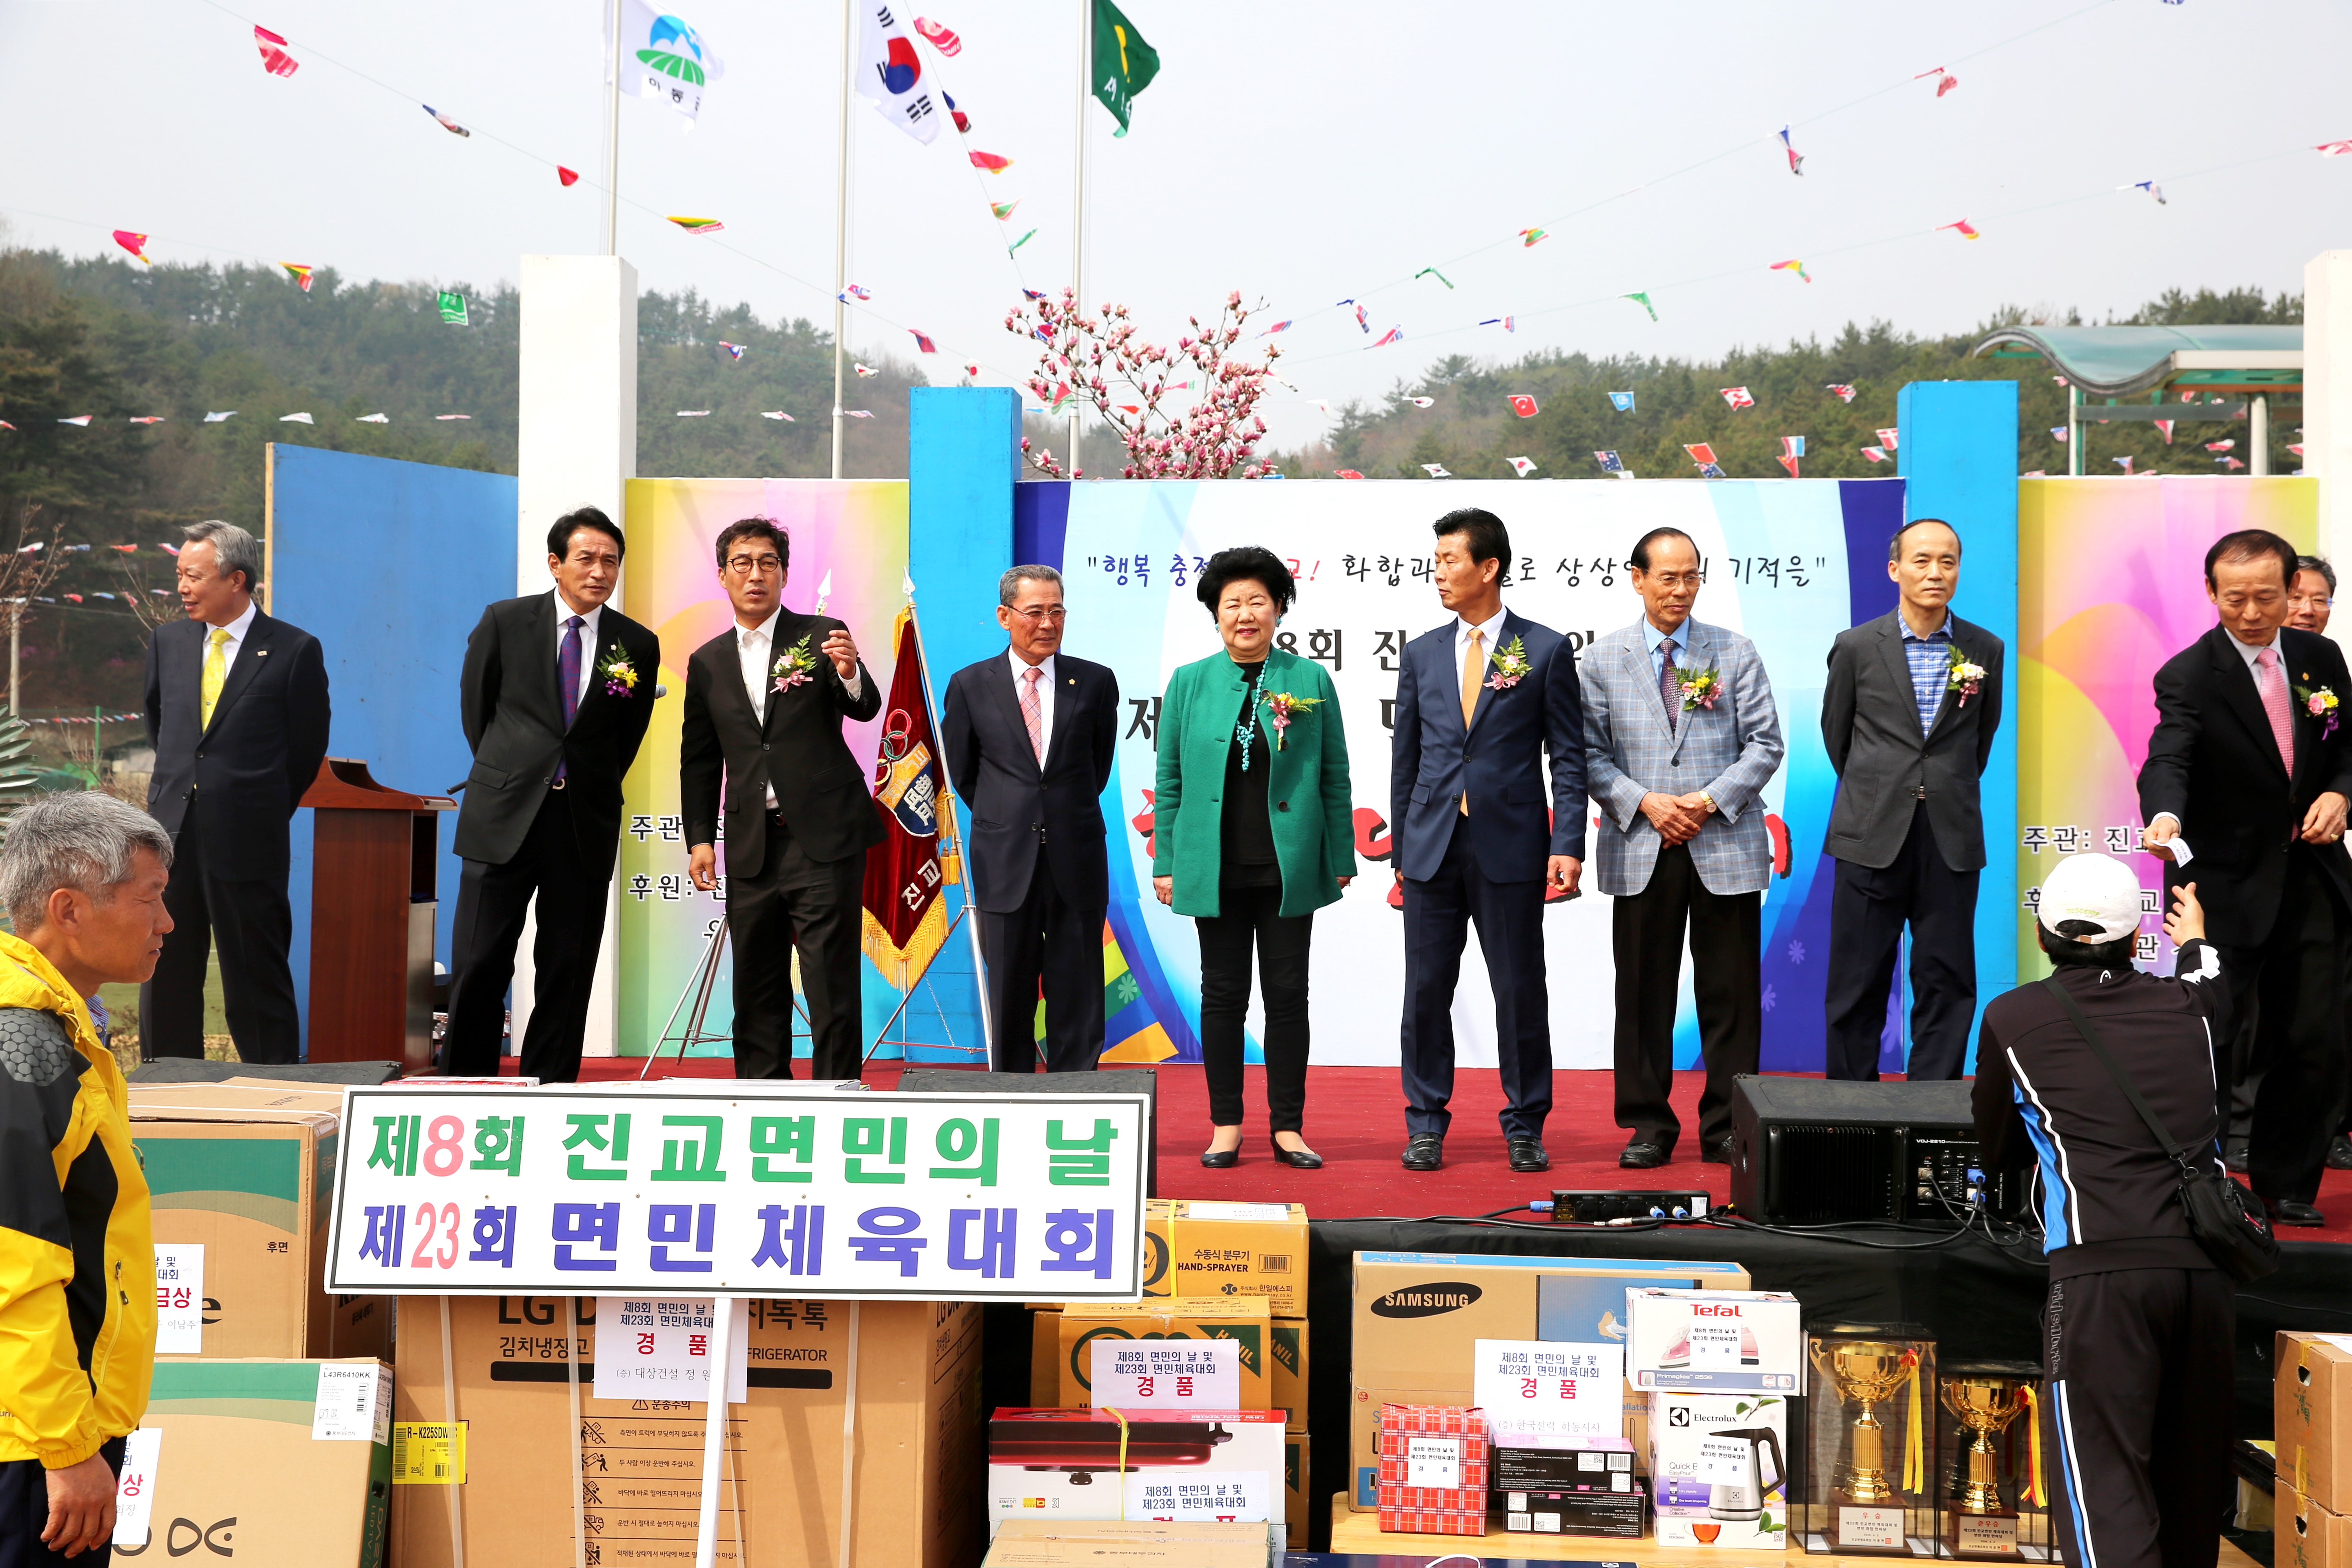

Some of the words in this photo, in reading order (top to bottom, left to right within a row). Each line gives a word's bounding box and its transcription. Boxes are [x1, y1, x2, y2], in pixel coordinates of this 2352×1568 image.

[2024, 827, 2089, 853] 주관:
[2066, 908, 2101, 918] DESCENTE
[367, 1115, 525, 1178] 제8회
[1046, 1119, 1119, 1187] 날
[358, 1202, 517, 1269] 제23회
[267, 1241, 289, 1254] 후면
[167, 1256, 176, 1267] 및
[1194, 1249, 1220, 1260] 수동식
[1223, 1250, 1250, 1261] 분무기
[1178, 1262, 1248, 1272] HAND-SPRAYER
[1259, 1284, 1292, 1293] 한일에스피
[1385, 1292, 1469, 1307] SAMSUNG
[624, 1301, 651, 1314] 제8회
[657, 1302, 689, 1315] 면민의
[696, 1304, 706, 1315] 날
[1690, 1304, 1743, 1317] Tefal
[168, 1319, 196, 1330] 이남주
[620, 1314, 653, 1326] 제23회
[499, 1336, 589, 1359] 김치냉장고
[637, 1333, 655, 1355] 경
[689, 1334, 707, 1356] 품
[1117, 1351, 1144, 1363] 제8회
[1150, 1352, 1180, 1363] 면민의
[1187, 1352, 1197, 1362] 날
[1203, 1352, 1212, 1362] 및
[1501, 1352, 1528, 1363] 제8회
[1535, 1353, 1565, 1365] 면민의
[1572, 1354, 1581, 1365] 날
[1587, 1355, 1597, 1366] 및
[616, 1368, 630, 1379] (증)
[635, 1367, 678, 1380] 대상건설
[685, 1369, 695, 1381] 정
[1114, 1363, 1147, 1374] 제23회
[1154, 1363, 1215, 1374] 면민체육대회
[1498, 1364, 1530, 1376] 제23회
[1537, 1366, 1599, 1378] 면민체육대회
[1137, 1376, 1154, 1396] 경
[1176, 1376, 1193, 1396] 품
[1521, 1378, 1537, 1398] 경
[1560, 1379, 1577, 1399] 품
[1694, 1414, 1737, 1423] Electrolux
[1499, 1420, 1512, 1430] (증)
[1517, 1420, 1555, 1431] 한국전력
[1561, 1421, 1600, 1434] 하동지사
[1669, 1462, 1690, 1470] Quick
[1145, 1486, 1172, 1497] 제8회
[1179, 1485, 1209, 1496] 면민의
[1216, 1484, 1226, 1495] 날
[1233, 1484, 1242, 1495] 및
[1142, 1498, 1176, 1510] 제23회
[1182, 1497, 1245, 1509] 면민체육대회
